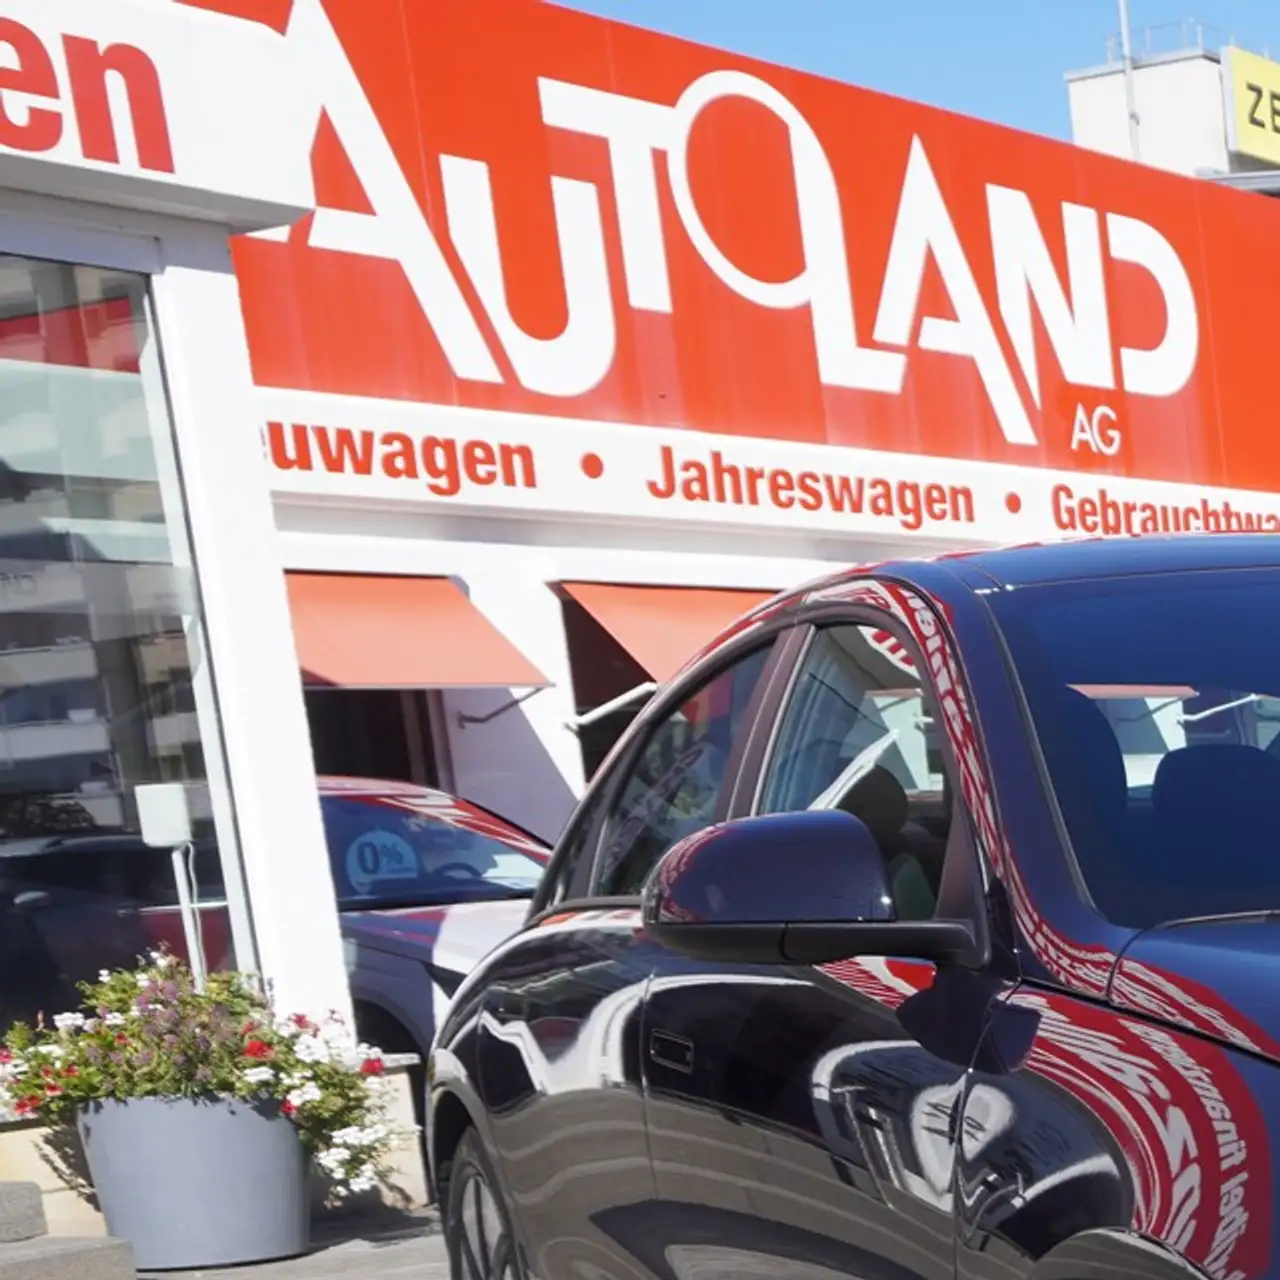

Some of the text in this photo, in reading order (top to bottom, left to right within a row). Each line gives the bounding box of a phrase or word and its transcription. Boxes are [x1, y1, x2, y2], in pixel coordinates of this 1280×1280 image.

[240, 0, 1198, 446] AUTOLAND
[1071, 404, 1121, 455] AG
[646, 445, 975, 530] Jahreswagen
